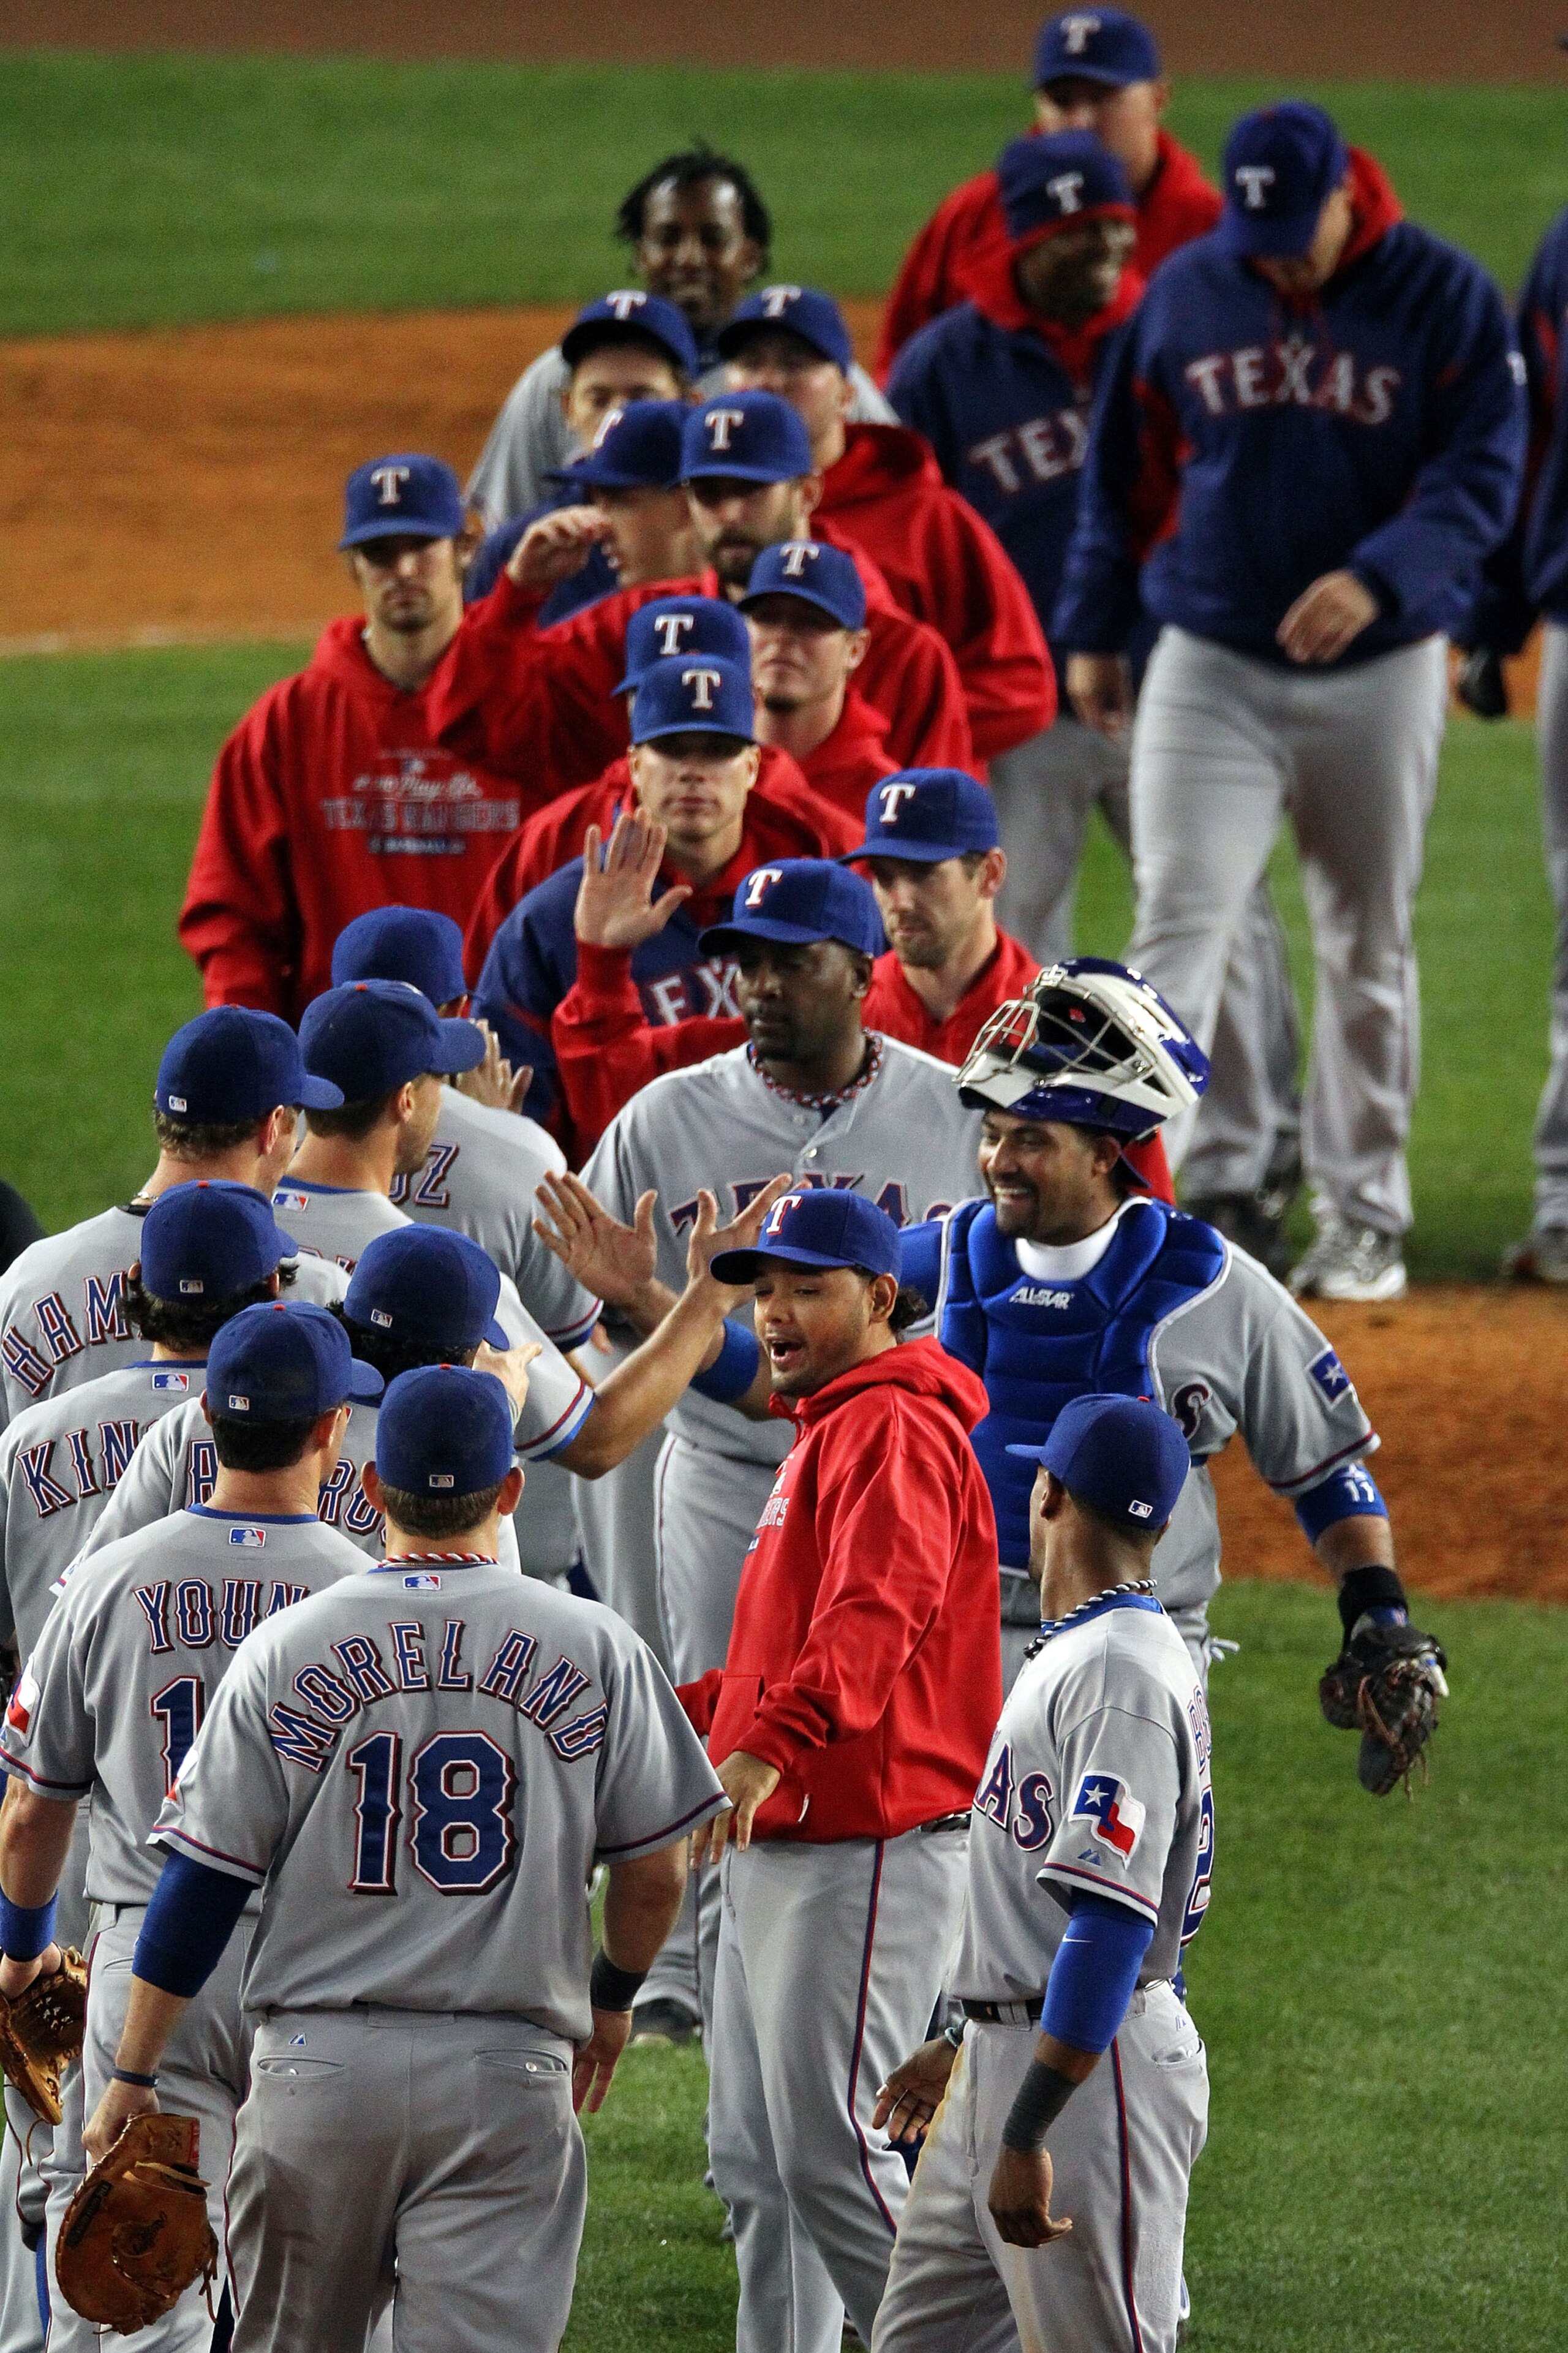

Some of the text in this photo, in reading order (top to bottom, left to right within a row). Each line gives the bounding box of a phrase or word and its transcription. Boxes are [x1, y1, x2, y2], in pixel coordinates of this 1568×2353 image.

[1061, 15, 1101, 54] T
[1046, 171, 1085, 215] T
[1235, 165, 1275, 210] T
[606, 289, 647, 320] T
[761, 284, 801, 317] T
[1183, 341, 1401, 426] TEXAS
[704, 409, 744, 451] T
[371, 466, 410, 504] T
[780, 543, 820, 575] T
[654, 614, 693, 655] T
[682, 669, 721, 709] T
[878, 783, 916, 824] T
[744, 868, 783, 907] T
[765, 1195, 802, 1236] T
[15, 1419, 158, 1519] KIN
[267, 1620, 610, 1773] MORELAND
[346, 1731, 518, 1895] 18
